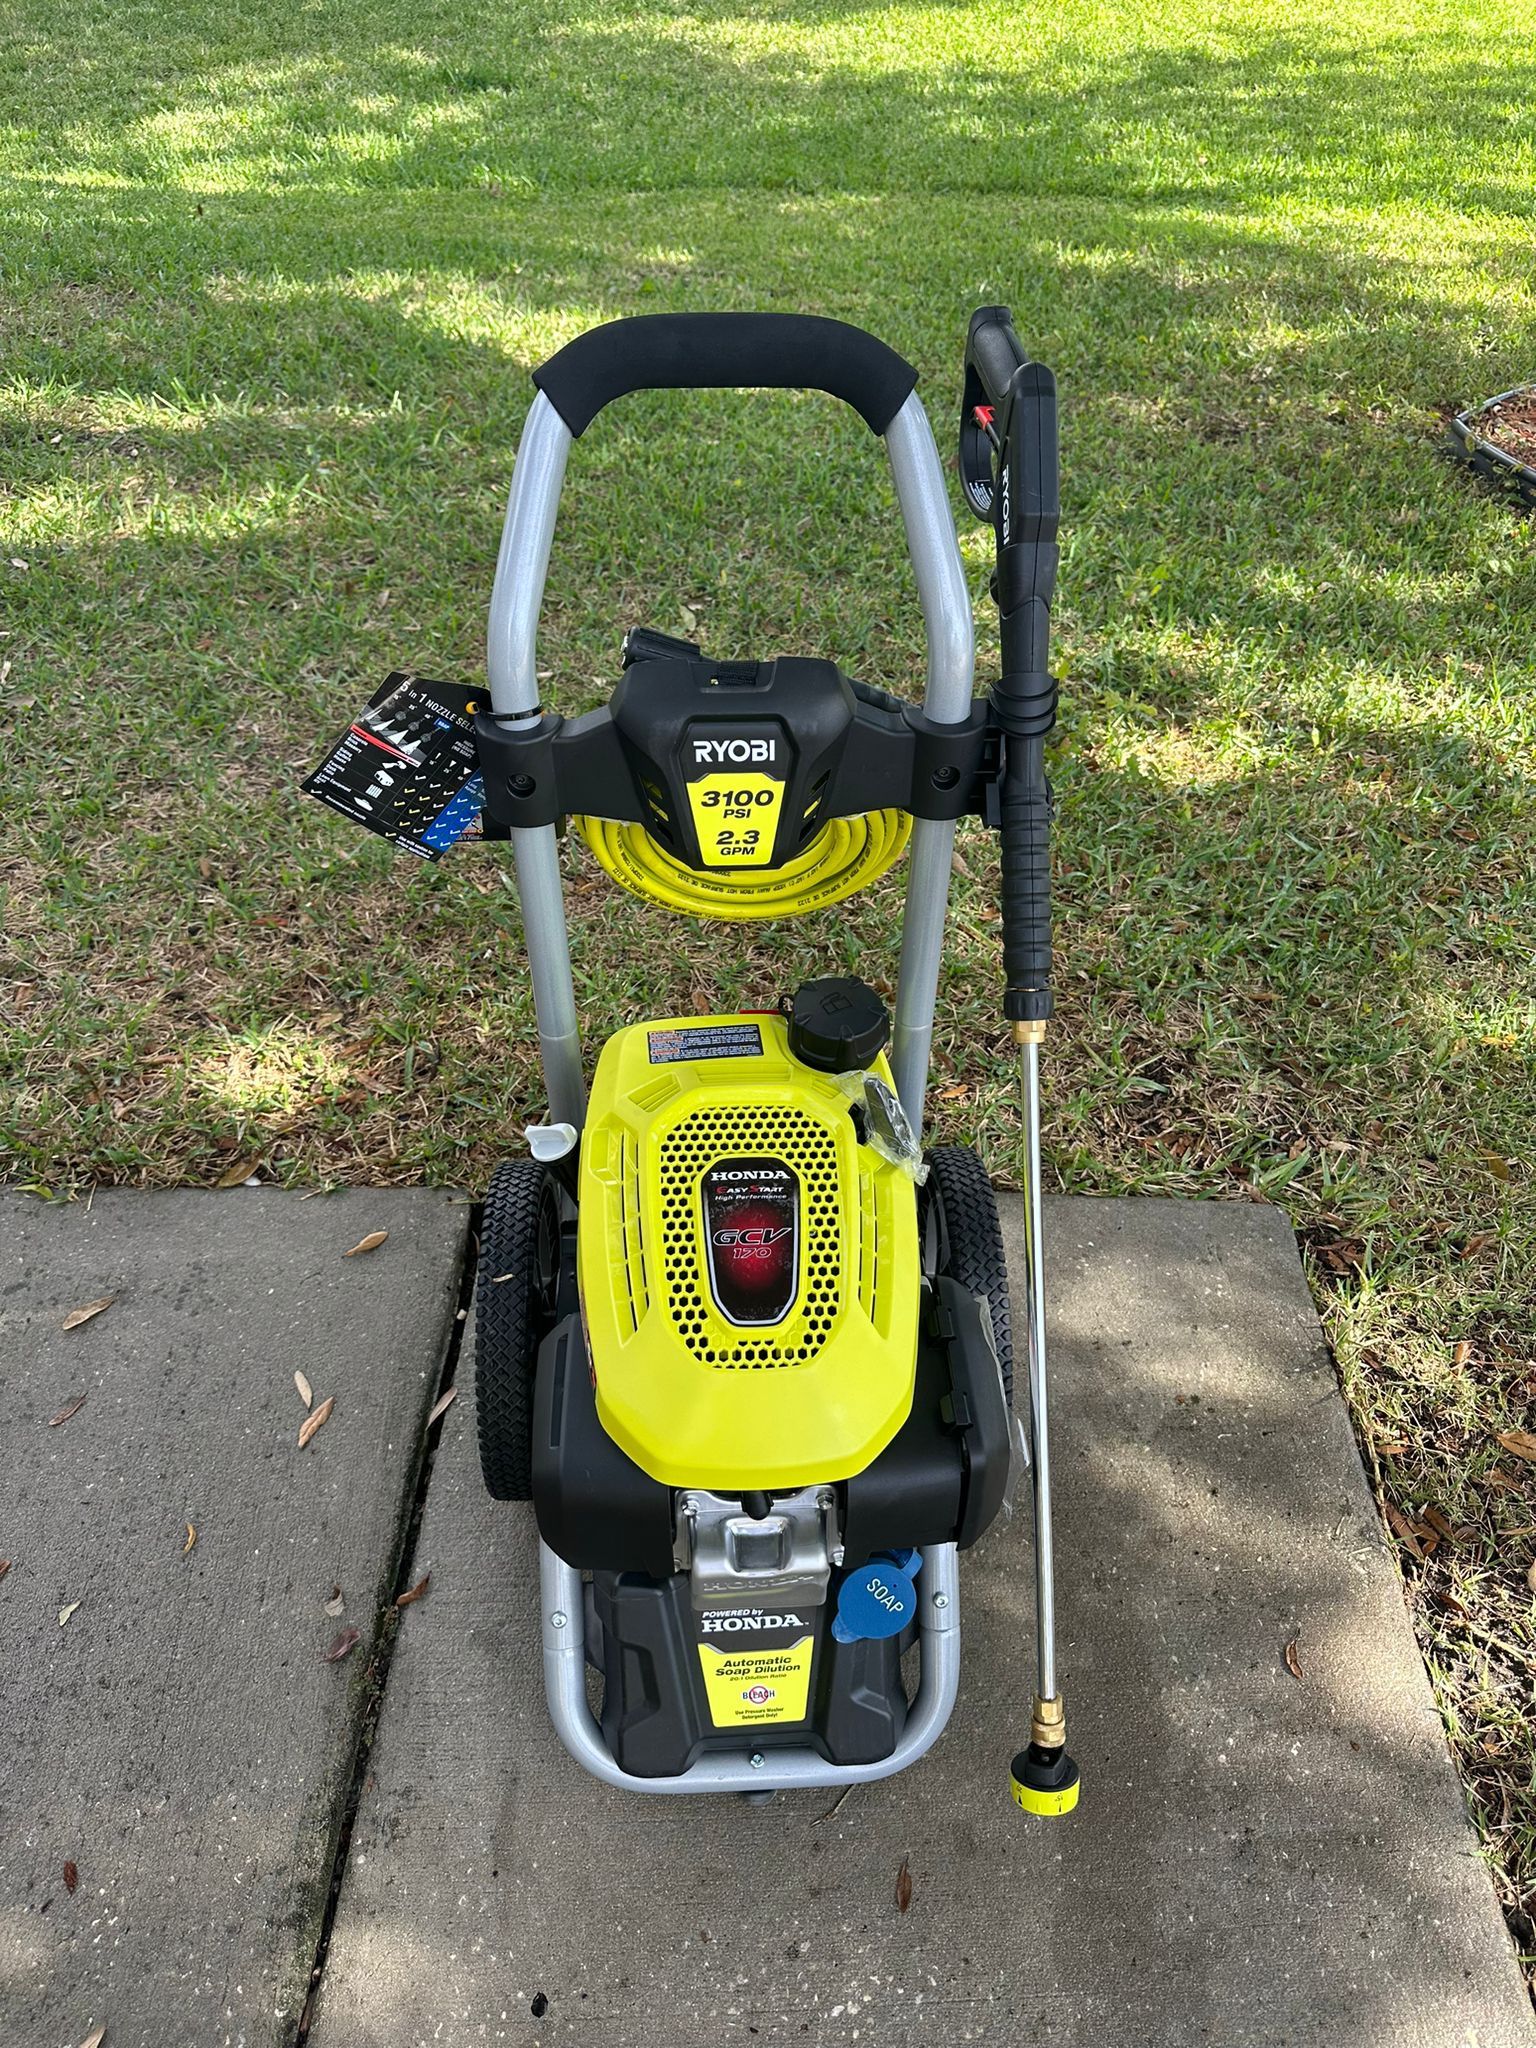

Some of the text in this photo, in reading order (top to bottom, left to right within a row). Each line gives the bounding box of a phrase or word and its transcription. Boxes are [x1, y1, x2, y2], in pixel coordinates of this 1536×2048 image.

[1002, 464, 1010, 545] RYOBI
[399, 680, 410, 692] 5
[409, 690, 418, 699] in
[418, 692, 427, 703] 1
[425, 699, 456, 722] NOZZLE
[693, 739, 776, 763] RYOBI
[700, 790, 775, 807] 3100
[723, 809, 751, 819] PSI
[715, 830, 760, 845] 2.3
[720, 847, 755, 856] GPM
[701, 883, 724, 893] SURFACE
[822, 884, 841, 898] SURFACE
[711, 1170, 790, 1181] HONDA
[716, 1184, 784, 1195] EASY START
[713, 1228, 792, 1246] GCV
[734, 1248, 772, 1259] 170
[867, 1578, 904, 1613] SOAP
[702, 1608, 764, 1618] POWERED by
[702, 1614, 803, 1633] HONDA
[724, 1656, 791, 1667] Automatic
[716, 1664, 800, 1676] Soap Dilution
[743, 1690, 775, 1700] BLEACH
